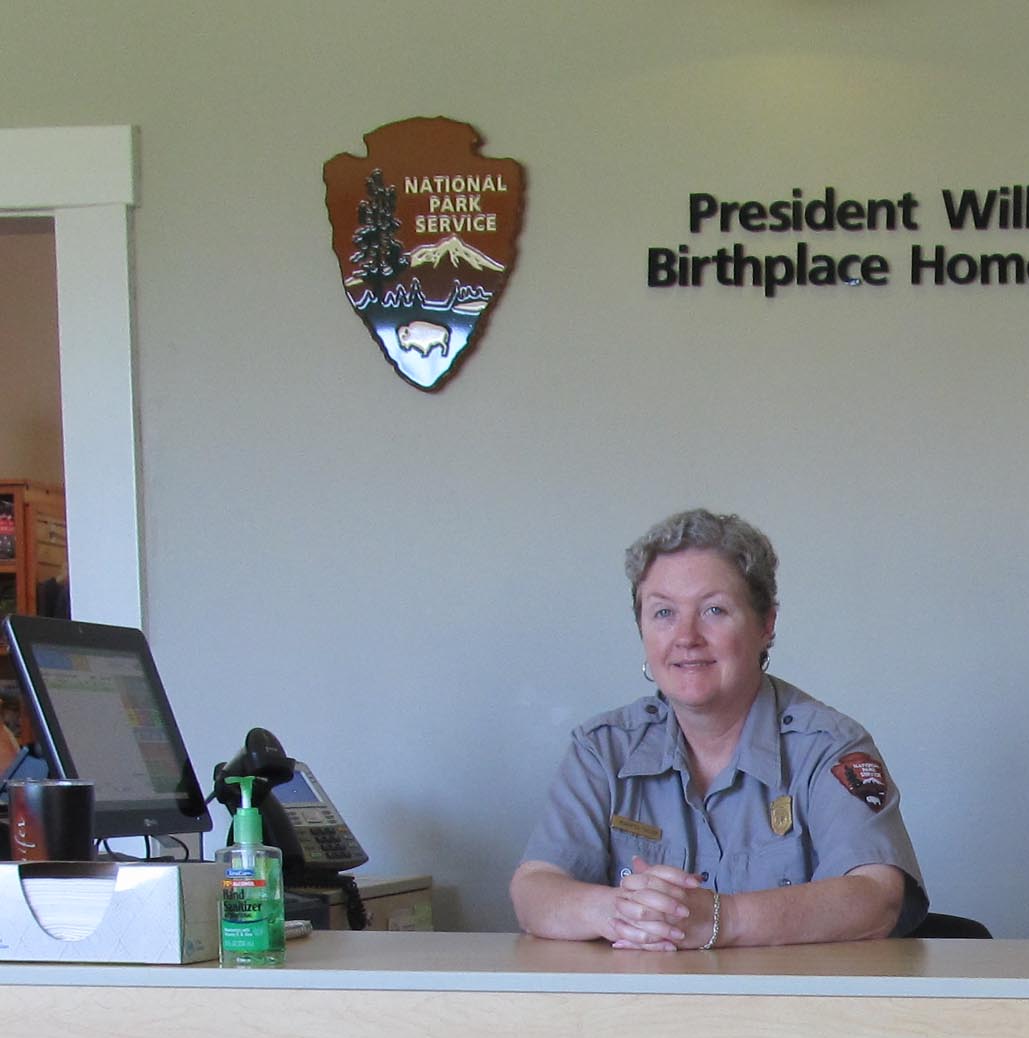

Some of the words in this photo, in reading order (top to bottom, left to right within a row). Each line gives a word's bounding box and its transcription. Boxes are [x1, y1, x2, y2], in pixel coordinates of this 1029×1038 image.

[405, 175, 507, 194] NATIONAL
[429, 194, 481, 212] PARK
[689, 187, 919, 233] President
[415, 213, 497, 232] SERVICE
[647, 242, 890, 298] Birthplace
[223, 889, 245, 900] Hand
[223, 901, 262, 912] Sanitizer
